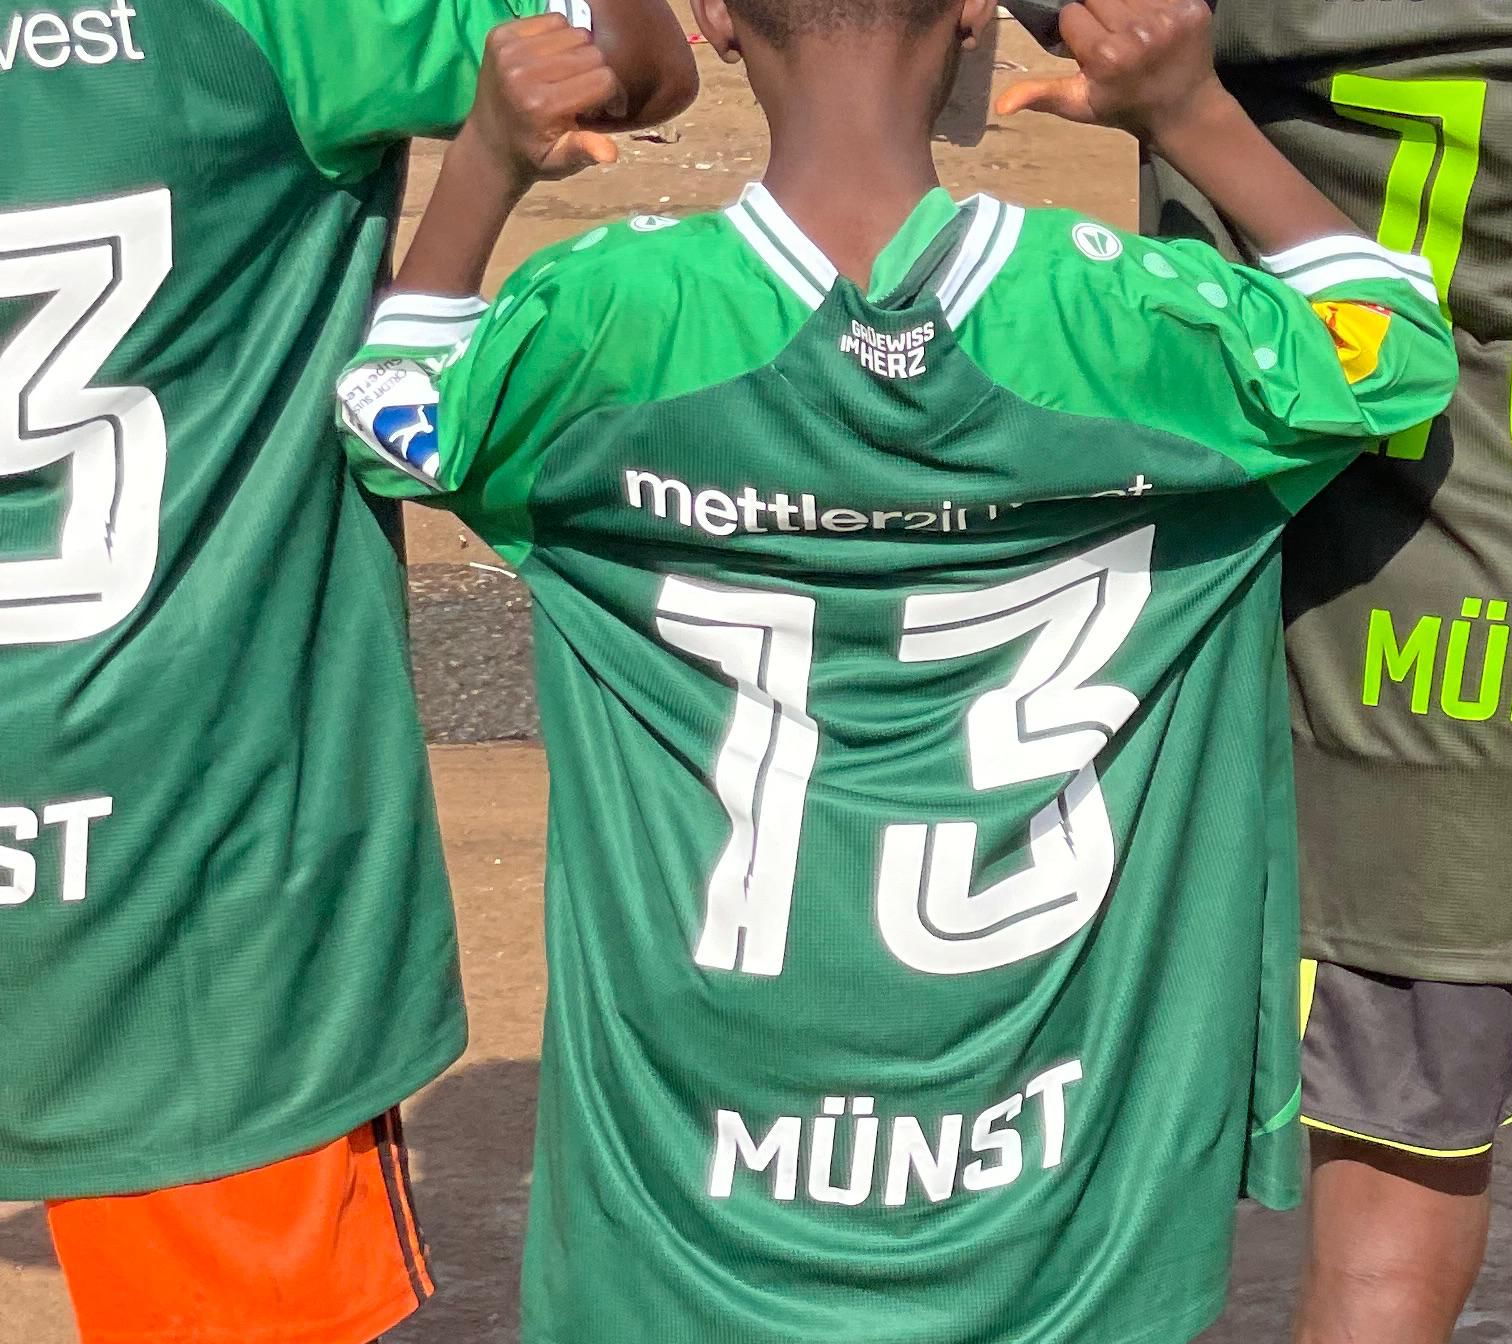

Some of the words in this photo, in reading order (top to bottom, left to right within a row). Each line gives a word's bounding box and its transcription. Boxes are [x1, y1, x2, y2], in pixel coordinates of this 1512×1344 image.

[840, 334, 860, 355] IM
[860, 344, 927, 379] HERZ
[653, 524, 1157, 981] 13
[702, 1058, 1084, 1207] MÜNST
